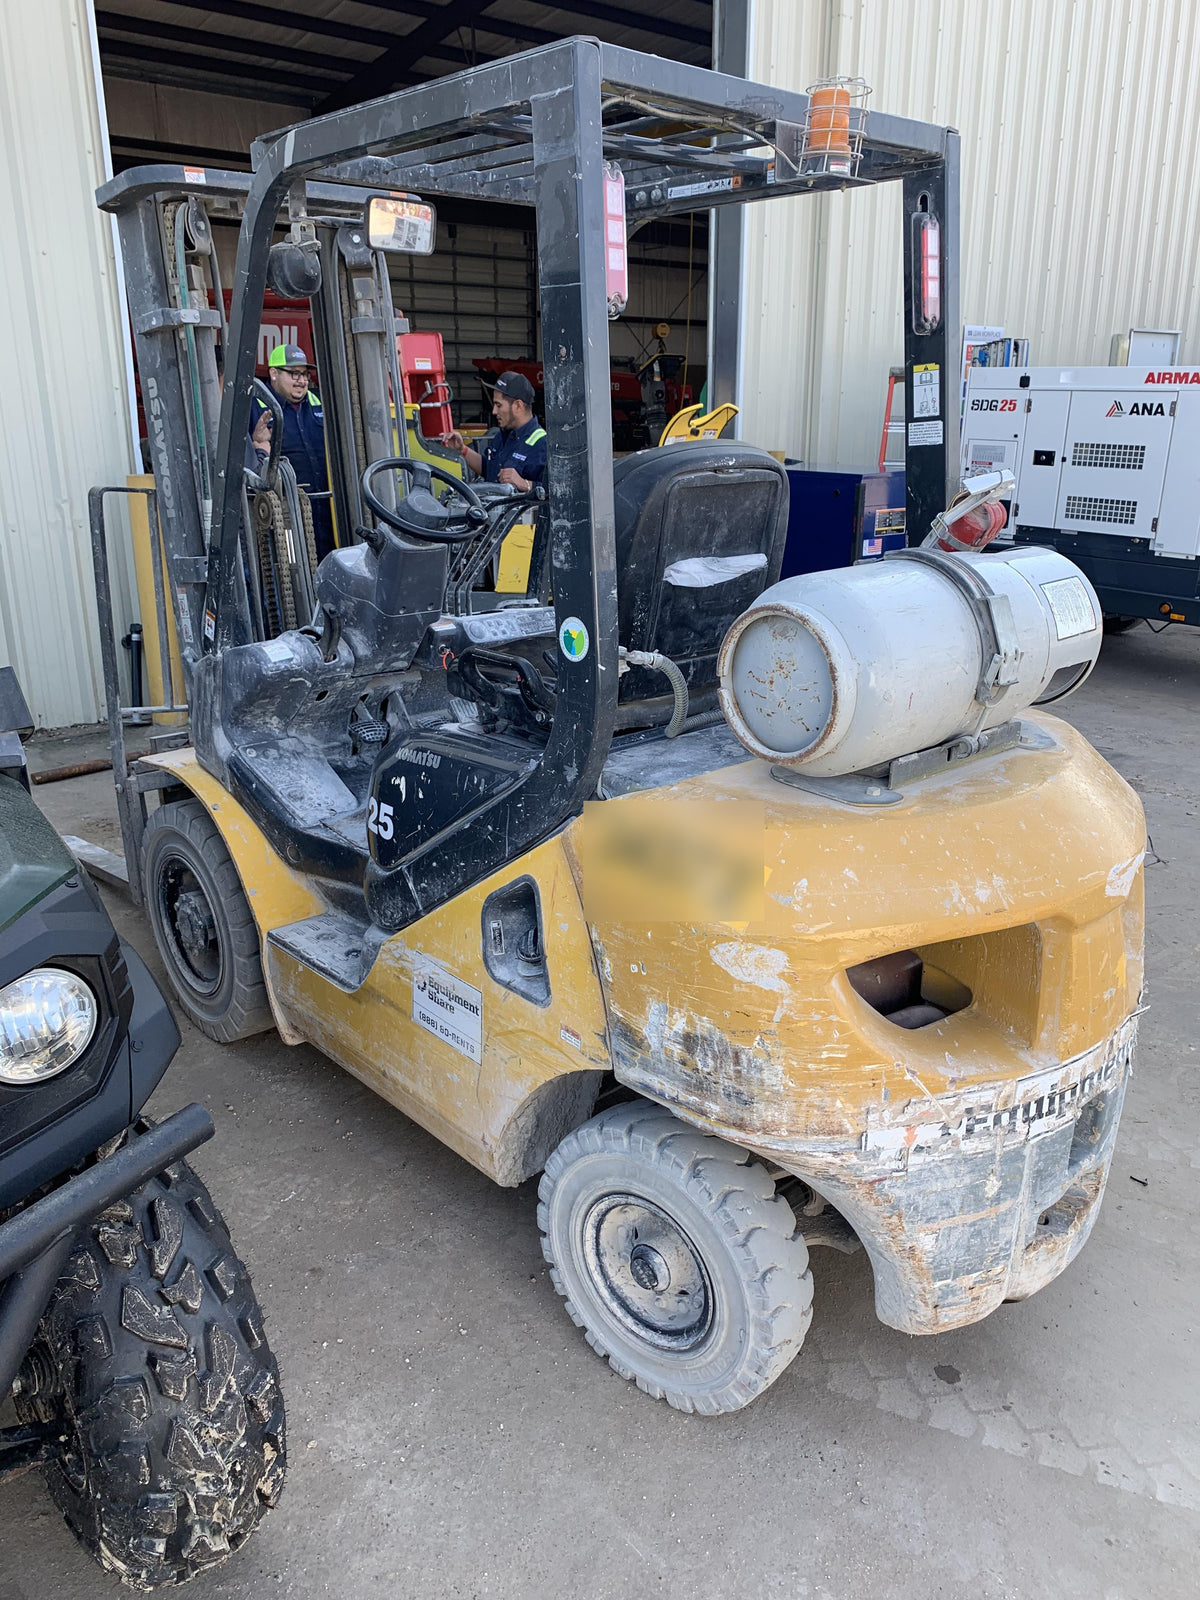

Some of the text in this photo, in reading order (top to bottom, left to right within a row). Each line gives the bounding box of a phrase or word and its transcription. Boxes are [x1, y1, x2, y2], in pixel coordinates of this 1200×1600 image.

[1128, 402, 1165, 416] ANA
[147, 377, 176, 518] KOMATSU
[395, 747, 442, 769] KOMATSU
[368, 796, 394, 840] 25
[427, 989, 455, 1014] Share
[428, 975, 480, 1017] Equipment
